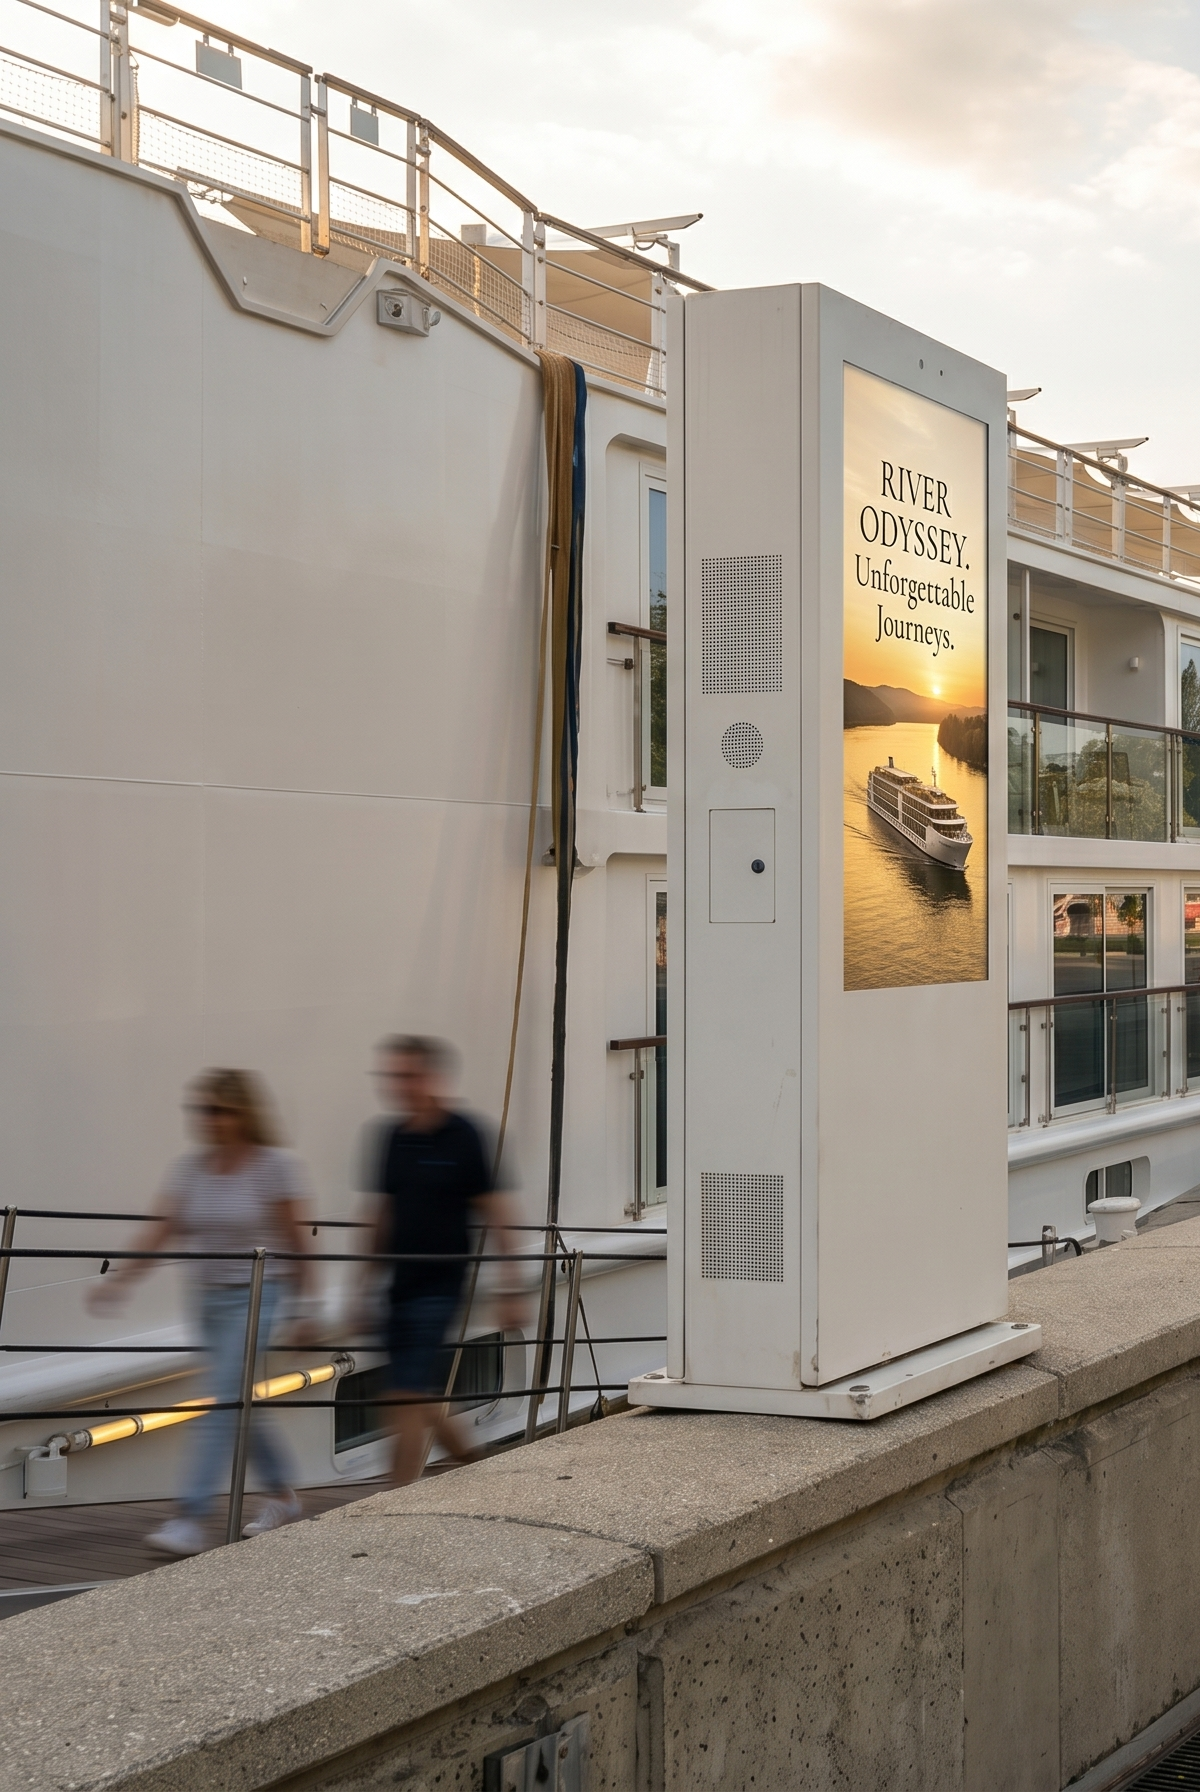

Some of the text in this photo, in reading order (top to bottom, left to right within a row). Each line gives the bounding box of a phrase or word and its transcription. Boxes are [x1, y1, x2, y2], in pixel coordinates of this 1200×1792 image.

[881, 460, 952, 518] RIVER
[860, 505, 970, 570] ODYSSEY.
[855, 553, 975, 613] Unforgettable
[875, 604, 955, 657] Journeys.
